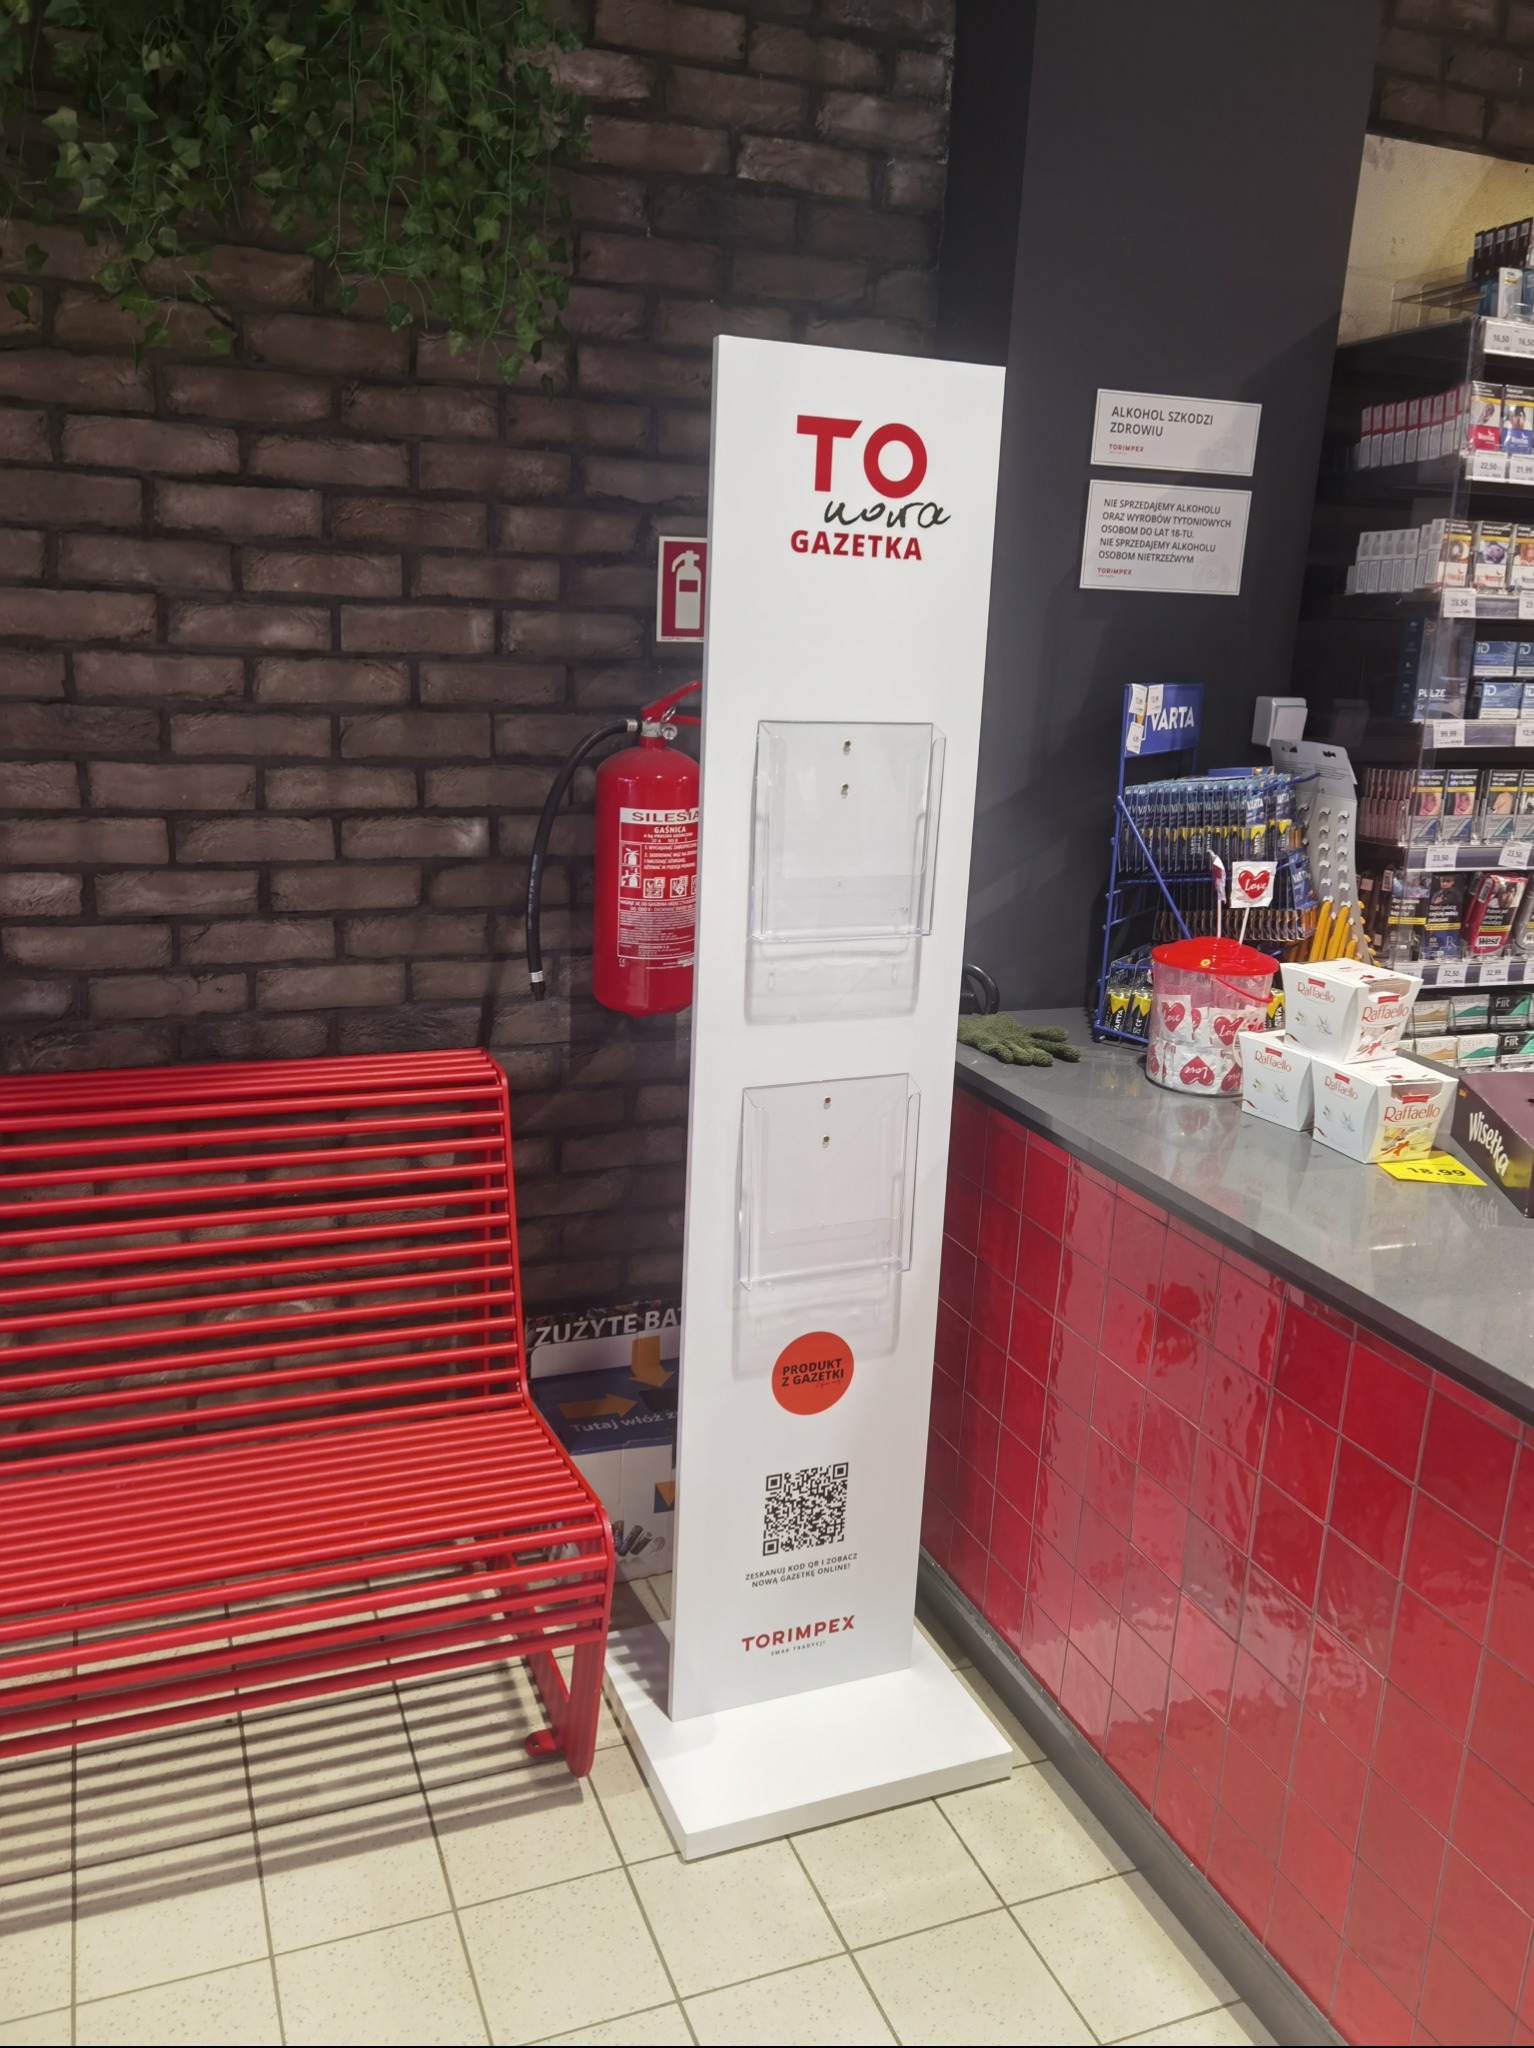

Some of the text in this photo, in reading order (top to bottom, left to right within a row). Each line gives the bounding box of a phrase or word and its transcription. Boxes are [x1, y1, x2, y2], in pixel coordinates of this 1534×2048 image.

[1111, 406, 1214, 426] ALKOHOL SZKODZI
[1110, 422, 1163, 437] ZDROWIU
[1109, 443, 1144, 453] TORIMPEX
[797, 415, 928, 499] TO
[1104, 498, 1221, 515] NIE SPRZEDAJEMY ALKOHOLU
[1102, 511, 1232, 528] ORAZ WYROBÓW TYTONIOWYCH
[1101, 524, 1195, 539] OSOBOM DO LAT 18-TU.
[790, 530, 922, 561] GAZETKA
[1100, 537, 1216, 553] NIE SPRZEDAJEMY ALKOHOLU
[1098, 550, 1194, 564] OSOBOM NIETRZEŹWYM
[1097, 567, 1133, 576] TORIMPEX
[1151, 706, 1195, 732] VARTA
[631, 811, 699, 823] SILESIA
[653, 825, 687, 835] GAŚNICA
[1245, 878, 1267, 891] Love
[1478, 937, 1499, 945] West
[1297, 981, 1335, 1003] Raffaello
[1163, 1009, 1182, 1023] Love
[1361, 1003, 1409, 1023] Raffaello
[1220, 1025, 1235, 1037] Lov
[1504, 1035, 1519, 1047] Fiit
[1255, 1051, 1292, 1072] Raffaello
[1184, 1065, 1208, 1079] Love
[1325, 1075, 1358, 1100] Raffaello
[1383, 1104, 1441, 1123] Raffaello
[534, 1308, 681, 1347] ZUŻYTE BA
[783, 1358, 842, 1376] PRODUKT
[782, 1376, 789, 1387] Z
[793, 1369, 844, 1385] GAZETKI
[570, 1419, 619, 1433] Tutaj
[621, 1412, 664, 1426] włóż
[745, 1567, 786, 1581] ZESKANUJ
[787, 1563, 806, 1571] KOD
[808, 1560, 819, 1569] QR
[826, 1553, 858, 1565] ZOBACZ
[752, 1563, 851, 1588] NOWĄ GAZETKĘ ONLINE!
[741, 1615, 855, 1652] TORIMPEX
[771, 1640, 826, 1656] SMAK TRADYCJI
